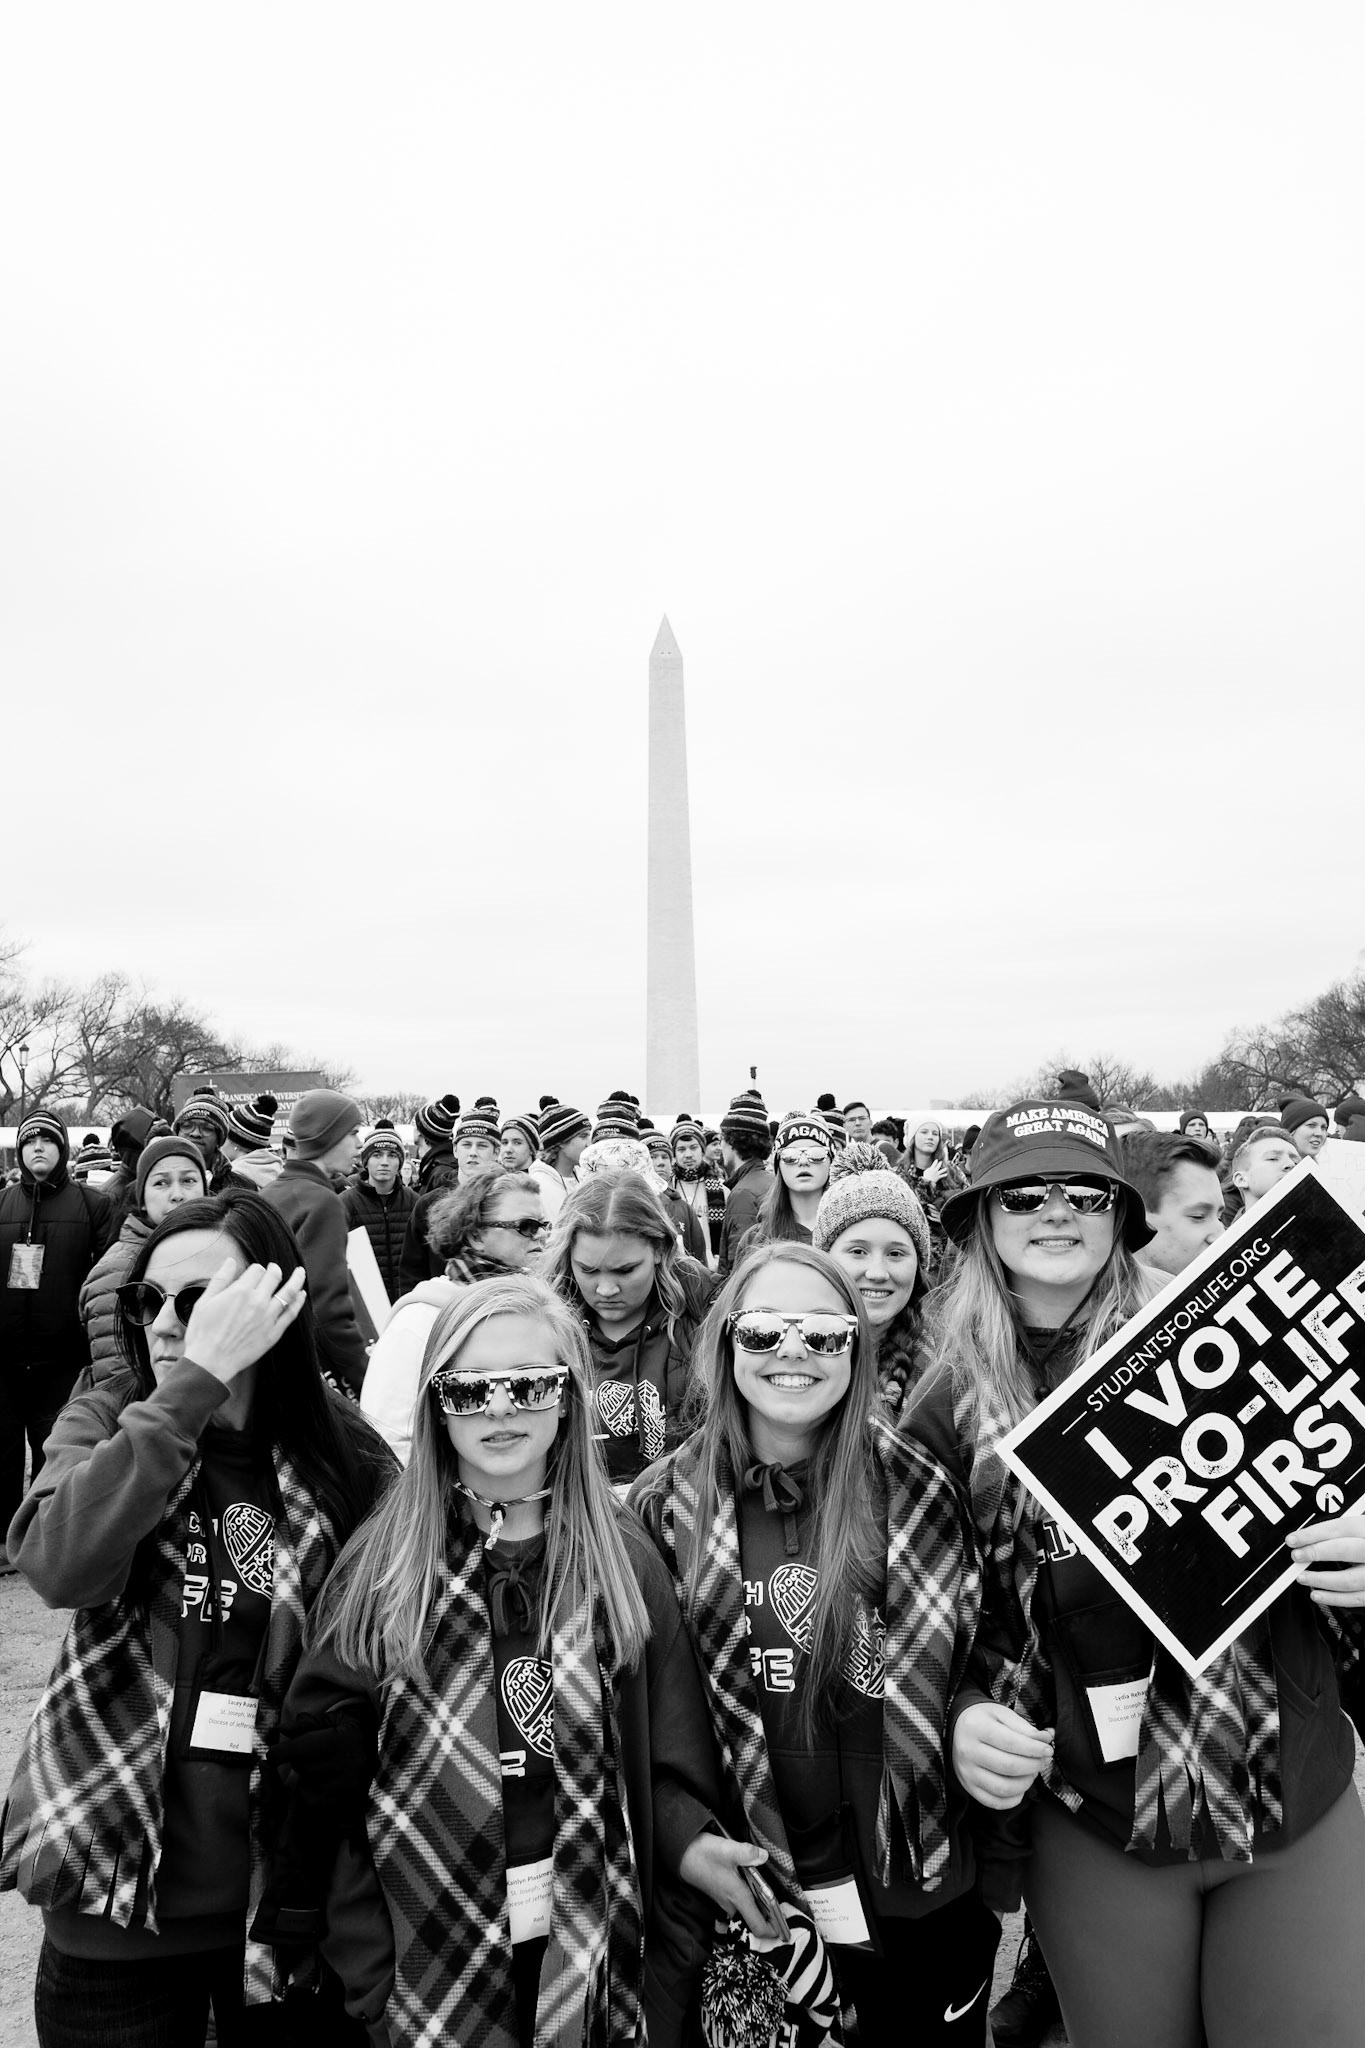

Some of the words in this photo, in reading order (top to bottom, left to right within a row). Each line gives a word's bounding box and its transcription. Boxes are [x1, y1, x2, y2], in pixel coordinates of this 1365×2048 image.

[788, 1126, 829, 1147] AGAIN
[1006, 1108, 1050, 1128] MAKE
[1051, 1108, 1109, 1138] AMERICA
[1014, 1120, 1064, 1137] GREAT
[1067, 1122, 1106, 1148] AGAIN
[1087, 1237, 1270, 1412] STUDENTSFORLIFE.ORG
[1084, 1426, 1133, 1480] I
[1124, 1249, 1321, 1427] VOTE
[1201, 1368, 1365, 1559] FIRST
[1115, 1693, 1130, 1701] Lydia
